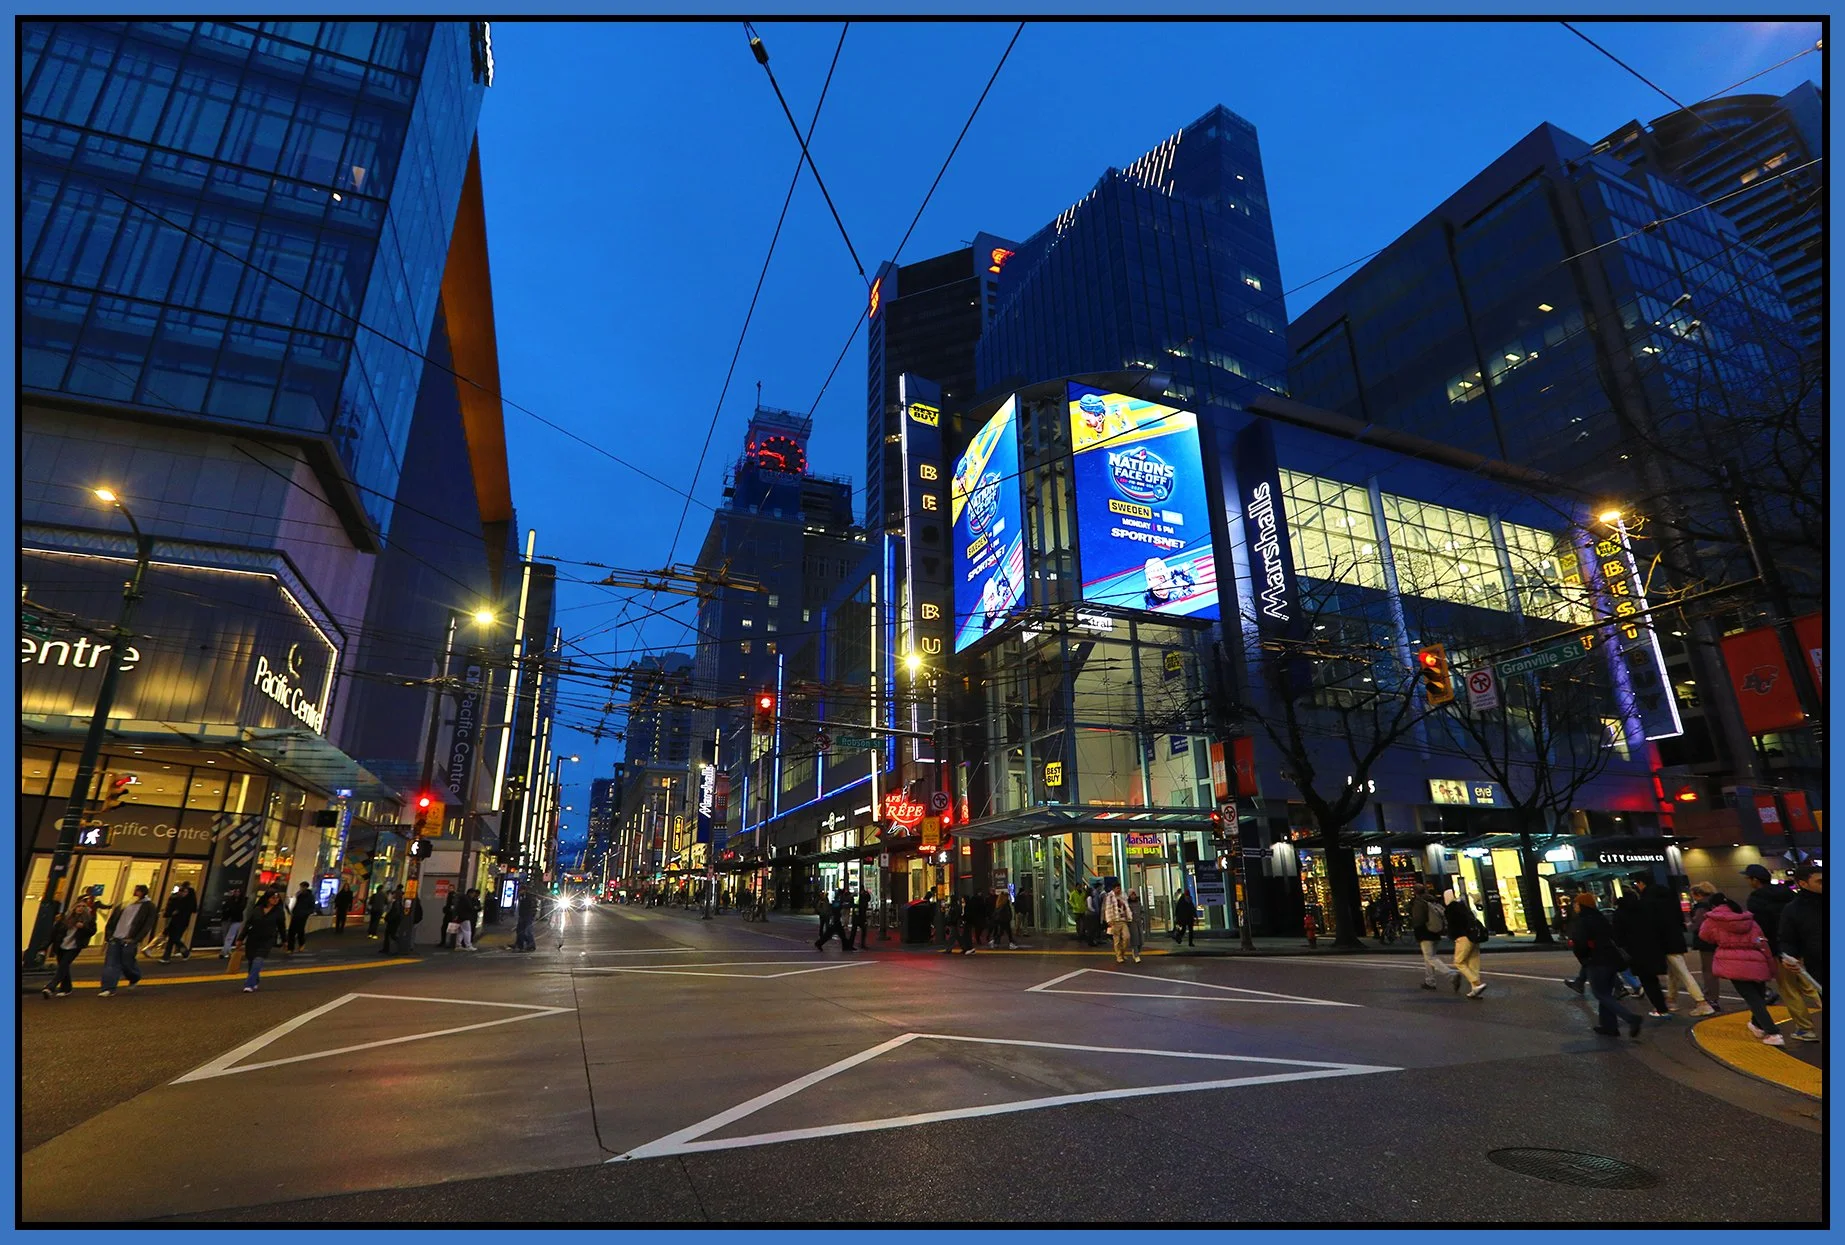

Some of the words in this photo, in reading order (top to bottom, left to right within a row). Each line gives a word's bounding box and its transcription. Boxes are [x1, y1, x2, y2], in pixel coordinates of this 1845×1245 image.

[914, 411, 935, 422] BUY
[1108, 452, 1175, 478] NATIONS
[1111, 502, 1150, 517] SWEDEN
[1122, 518, 1151, 530] MONDAY
[1163, 526, 1174, 534] PM
[1111, 528, 1186, 548] SPORTSNET
[1248, 481, 1290, 622] Marshalls
[1501, 652, 1558, 675] Granville
[1562, 645, 1580, 658] St
[254, 655, 293, 709] Pacific
[291, 688, 321, 736] Centre
[456, 690, 478, 738] Pacific
[841, 738, 871, 748] Robson
[448, 741, 470, 793] Centre
[1046, 766, 1061, 775] BEST
[1047, 774, 1060, 784] BUY
[1474, 786, 1492, 798] eye
[153, 824, 211, 841] Centre
[1600, 854, 1625, 863] CITY
